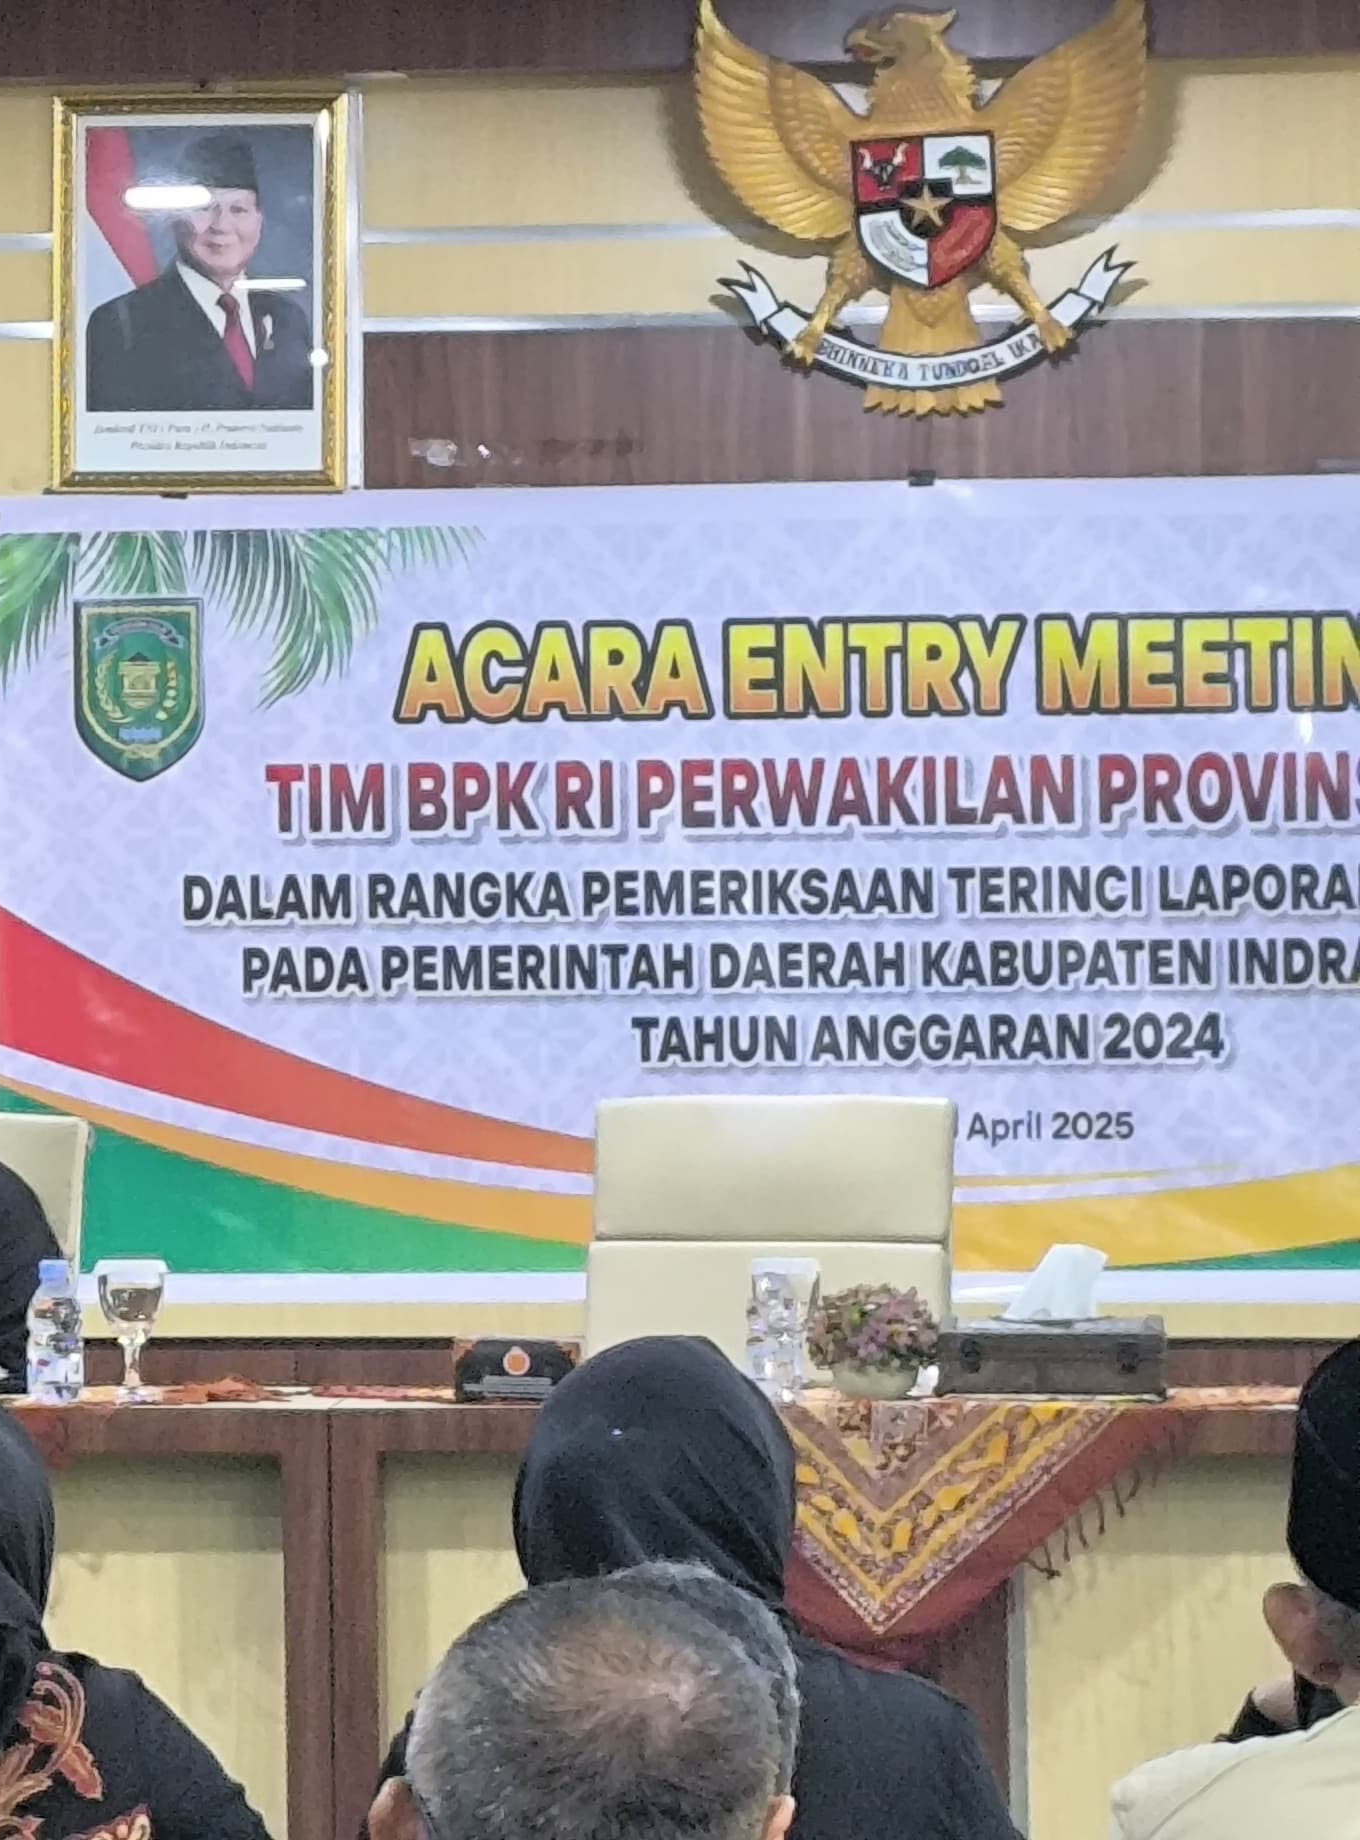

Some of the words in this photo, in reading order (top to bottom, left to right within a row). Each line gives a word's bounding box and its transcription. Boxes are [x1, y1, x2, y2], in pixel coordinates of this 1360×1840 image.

[395, 622, 714, 721] ACARA
[723, 615, 1024, 718] ENTRY
[265, 762, 385, 833] TIM
[407, 760, 539, 832] BPK
[555, 759, 614, 830] RI
[638, 754, 1076, 829] PERWAKILAN
[1098, 750, 1360, 825] PROVIN
[182, 874, 352, 922] DALAM
[367, 871, 570, 920] RANGKA
[582, 868, 934, 916] PEMERIKSAAN
[947, 865, 1144, 914] TERINCI
[1157, 863, 1360, 912] LAPORA
[241, 946, 368, 994] PADA
[381, 943, 694, 992] PEMERINTAH
[709, 940, 906, 990] DAERAH
[921, 937, 1212, 987] KABUPATEN
[1227, 937, 1360, 986] INDR
[631, 1014, 797, 1064] TAHUN
[810, 1014, 1089, 1063] ANGGARAN
[1102, 1011, 1225, 1060] 2024
[966, 1109, 1042, 1148] April
[1051, 1111, 1135, 1140] 2025
